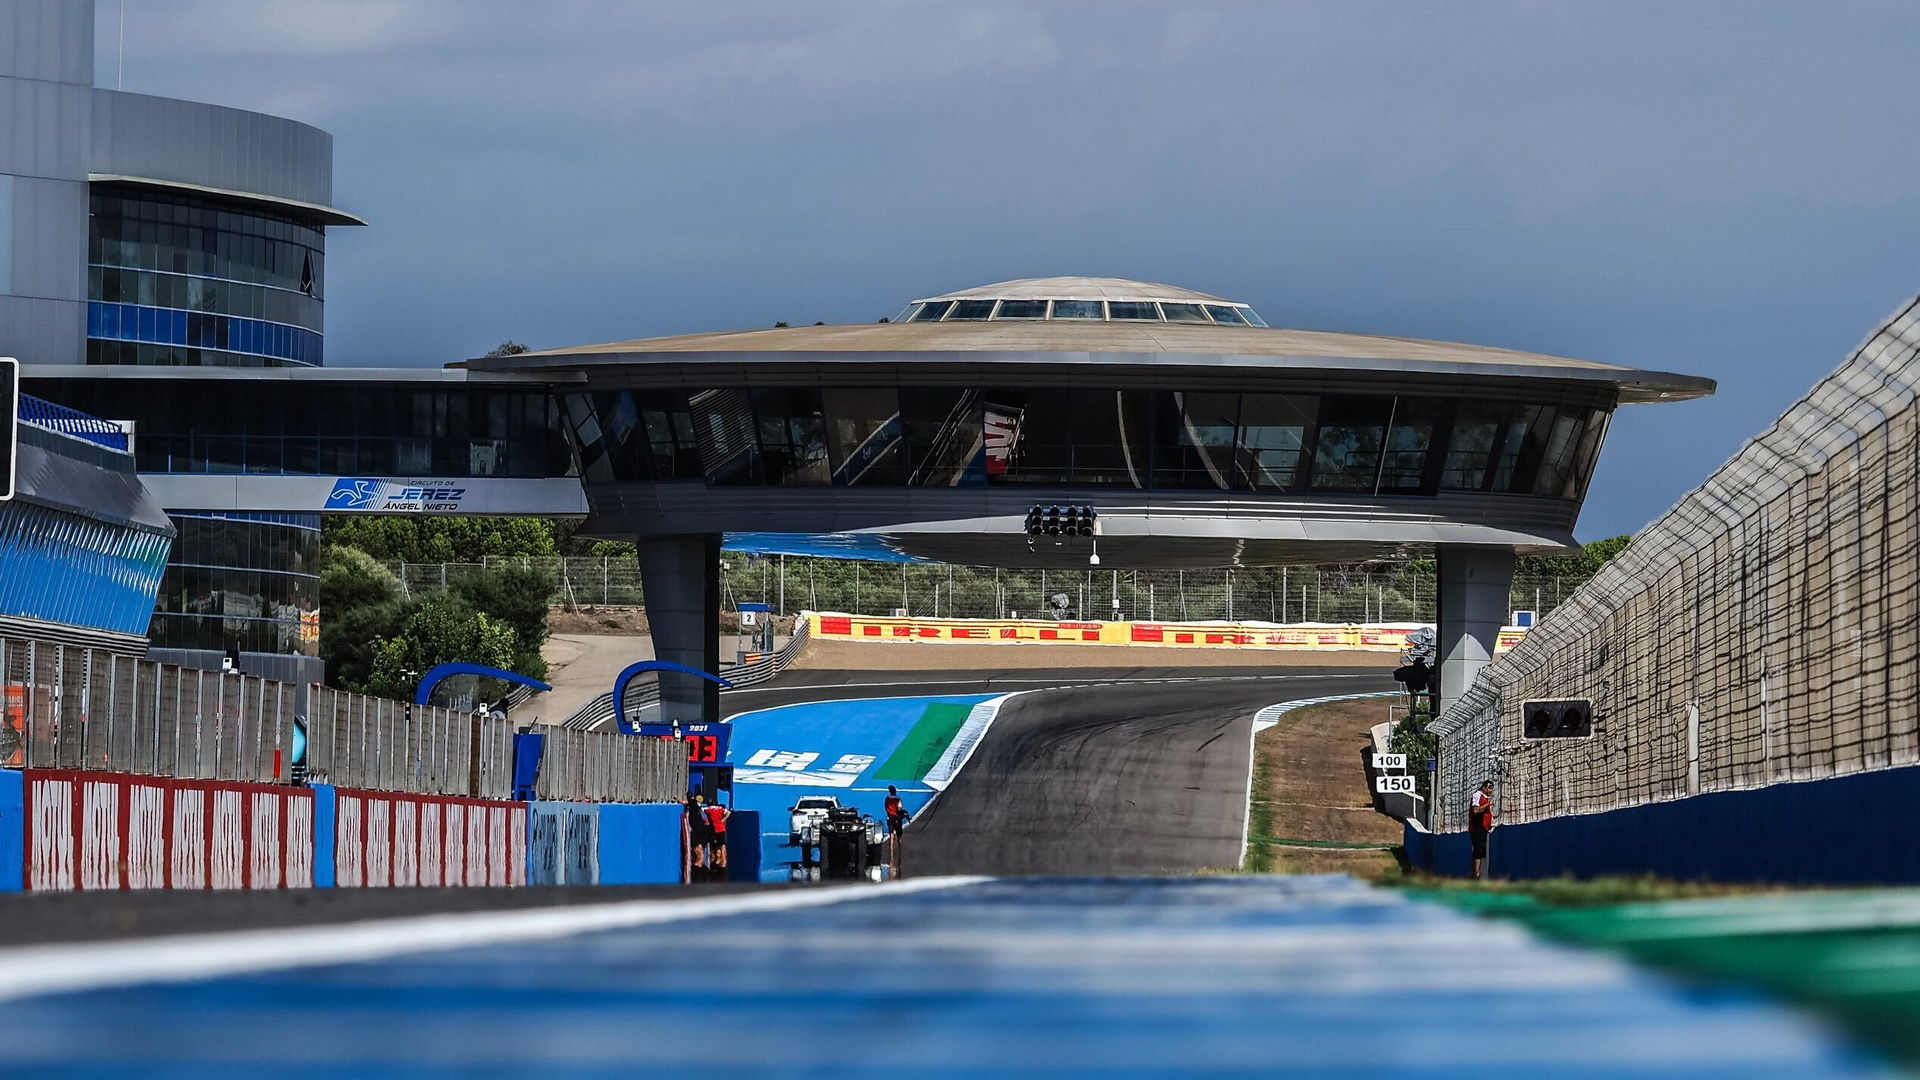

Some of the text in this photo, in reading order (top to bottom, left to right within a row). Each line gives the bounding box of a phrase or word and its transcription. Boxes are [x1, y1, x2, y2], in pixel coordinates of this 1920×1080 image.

[388, 488, 466, 501] JEREZ
[382, 500, 458, 511] ÁNGEL NIETO
[689, 724, 709, 732] 2021
[1378, 756, 1401, 766] 100
[1380, 778, 1411, 791] 150
